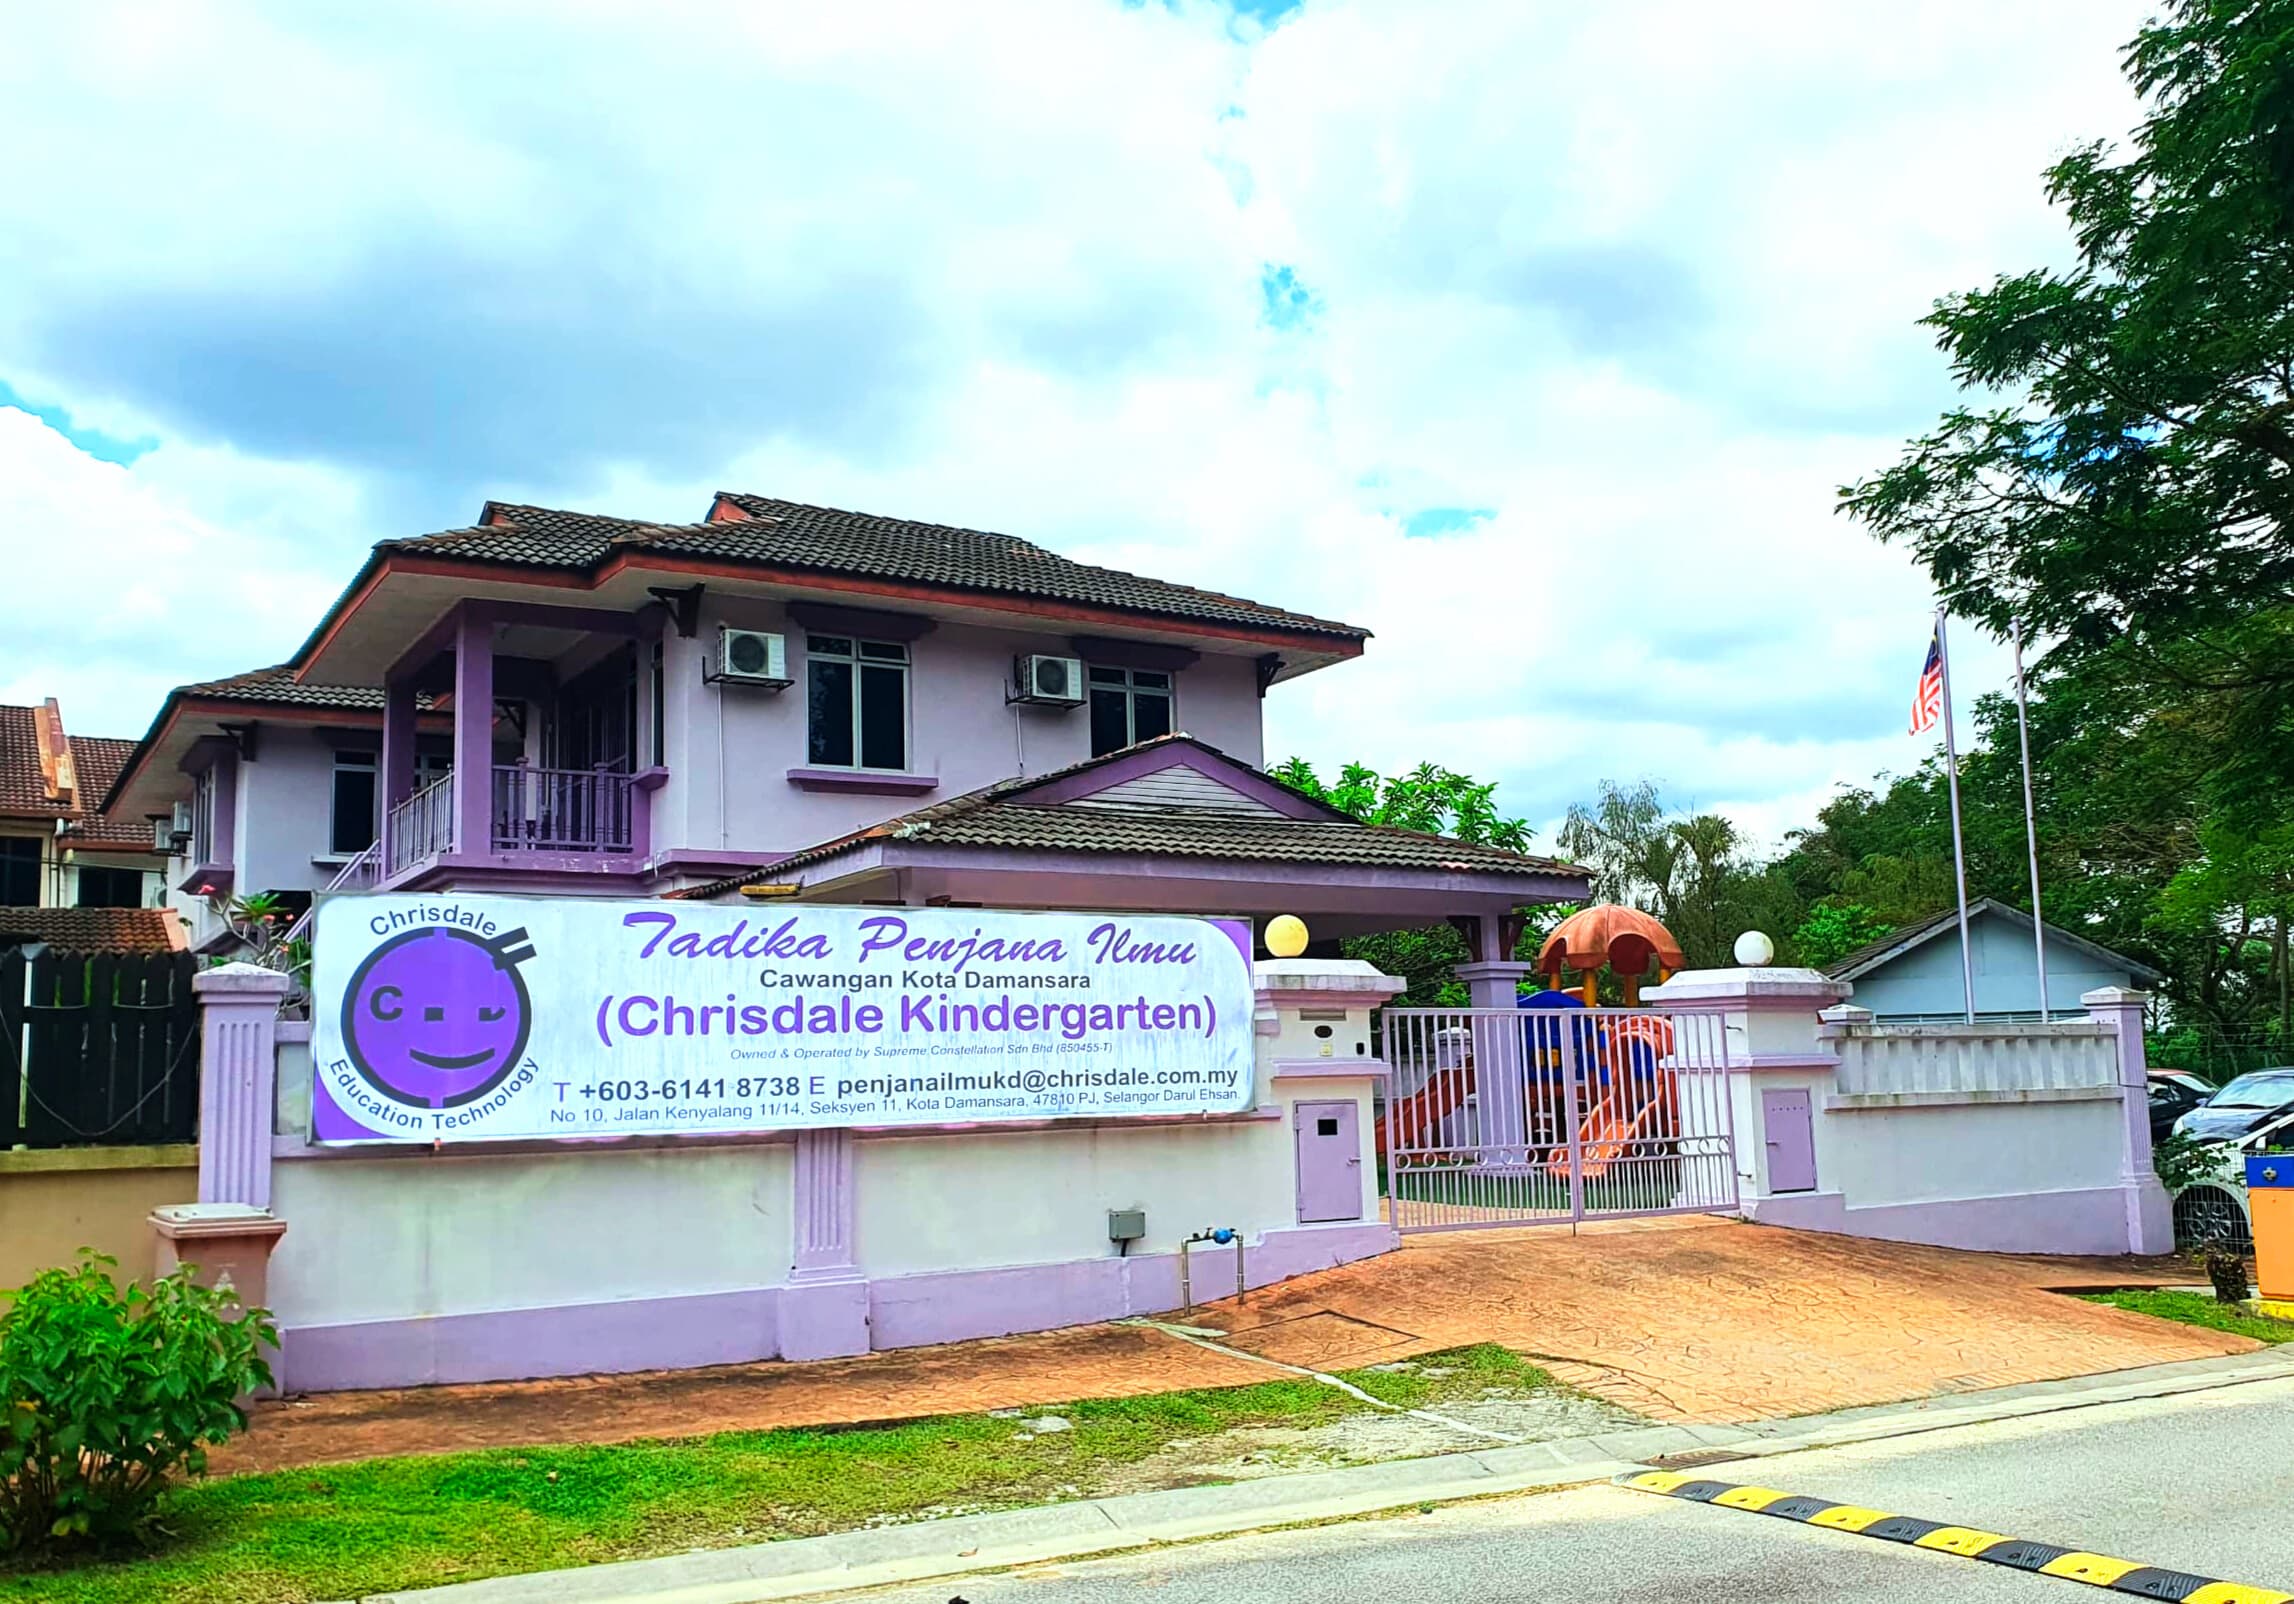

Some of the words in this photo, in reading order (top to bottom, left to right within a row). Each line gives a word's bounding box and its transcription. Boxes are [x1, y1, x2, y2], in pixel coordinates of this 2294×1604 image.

[370, 903, 497, 936] Chrisdale
[623, 911, 833, 959] Tadika
[858, 916, 1068, 974] Penjana
[1087, 923, 1196, 964] Ilmu
[760, 969, 892, 993] Cawangan
[902, 970, 956, 989] Kota
[965, 971, 1091, 989] Damansara
[597, 993, 884, 1047] (Chrisdale
[901, 993, 1217, 1040] Kindergarten)
[730, 1048, 776, 1060] Owned
[781, 1048, 789, 1059] &
[794, 1047, 852, 1060] Operated
[855, 1047, 870, 1058] by
[874, 1045, 926, 1058] Supreme
[930, 1044, 1003, 1056] Constellation
[1007, 1043, 1029, 1054] Sdn
[1032, 1043, 1053, 1054] Bhd
[329, 1059, 423, 1130] Education
[432, 1056, 539, 1130] Technology
[553, 1082, 571, 1102] T
[579, 1078, 725, 1101] +603-6141
[736, 1076, 800, 1097] 8738
[809, 1076, 825, 1095] E
[837, 1067, 1238, 1099] penjanailmukd@chrisdale.com.my
[550, 1109, 575, 1123] No
[583, 1108, 608, 1123] 10,
[614, 1107, 659, 1121] Jalan
[665, 1105, 752, 1121] Kenyalang
[760, 1103, 805, 1117] 11/14,
[810, 1100, 876, 1116] Seksyen
[882, 1099, 901, 1112] 11,
[906, 1094, 940, 1110] Kota
[945, 1094, 1028, 1109] Damansara,
[1033, 1093, 1074, 1106] 47810
[1079, 1092, 1099, 1105] PJ,
[1104, 1090, 1160, 1105] Selangor
[1163, 1089, 1196, 1102] Darul
